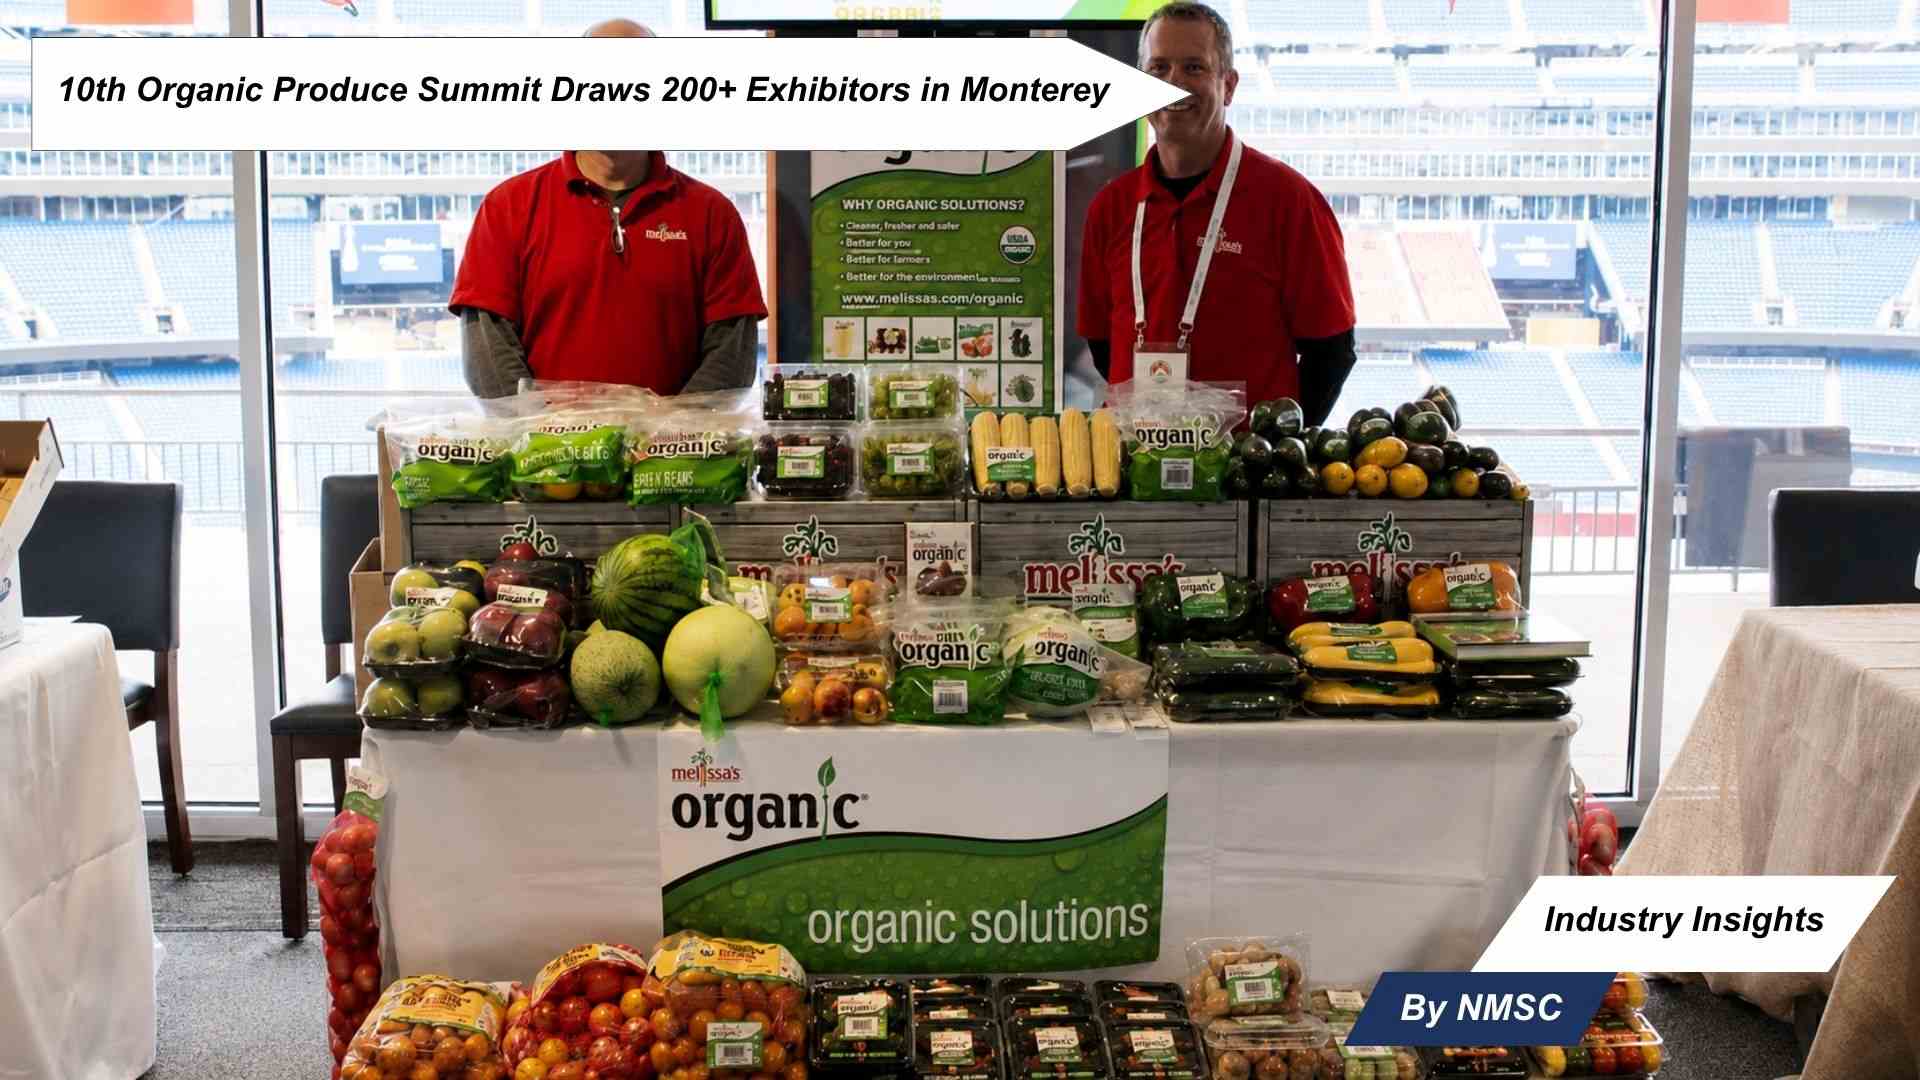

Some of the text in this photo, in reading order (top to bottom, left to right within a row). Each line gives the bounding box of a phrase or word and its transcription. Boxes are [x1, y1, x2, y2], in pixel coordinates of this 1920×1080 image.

[842, 199, 1025, 210] WHY ORGANIC SOLUTIONS?
[847, 221, 960, 231] Cleaner, fresher and safer
[846, 238, 912, 249] Better for you
[846, 254, 876, 264] Better
[878, 254, 891, 264] for
[846, 272, 877, 282] Better
[879, 272, 894, 282] for
[896, 272, 913, 282] the
[842, 293, 1024, 307] www.melissas.com/organic
[1135, 425, 1212, 450] organic
[418, 441, 494, 463] organic
[647, 438, 723, 457] organic
[664, 471, 694, 488] BEANS
[913, 545, 967, 564] organic
[901, 640, 990, 667] organic
[1034, 640, 1101, 671] organic
[671, 762, 741, 784] melissa's
[672, 776, 860, 841] organic
[808, 898, 1149, 954] organic solutions
